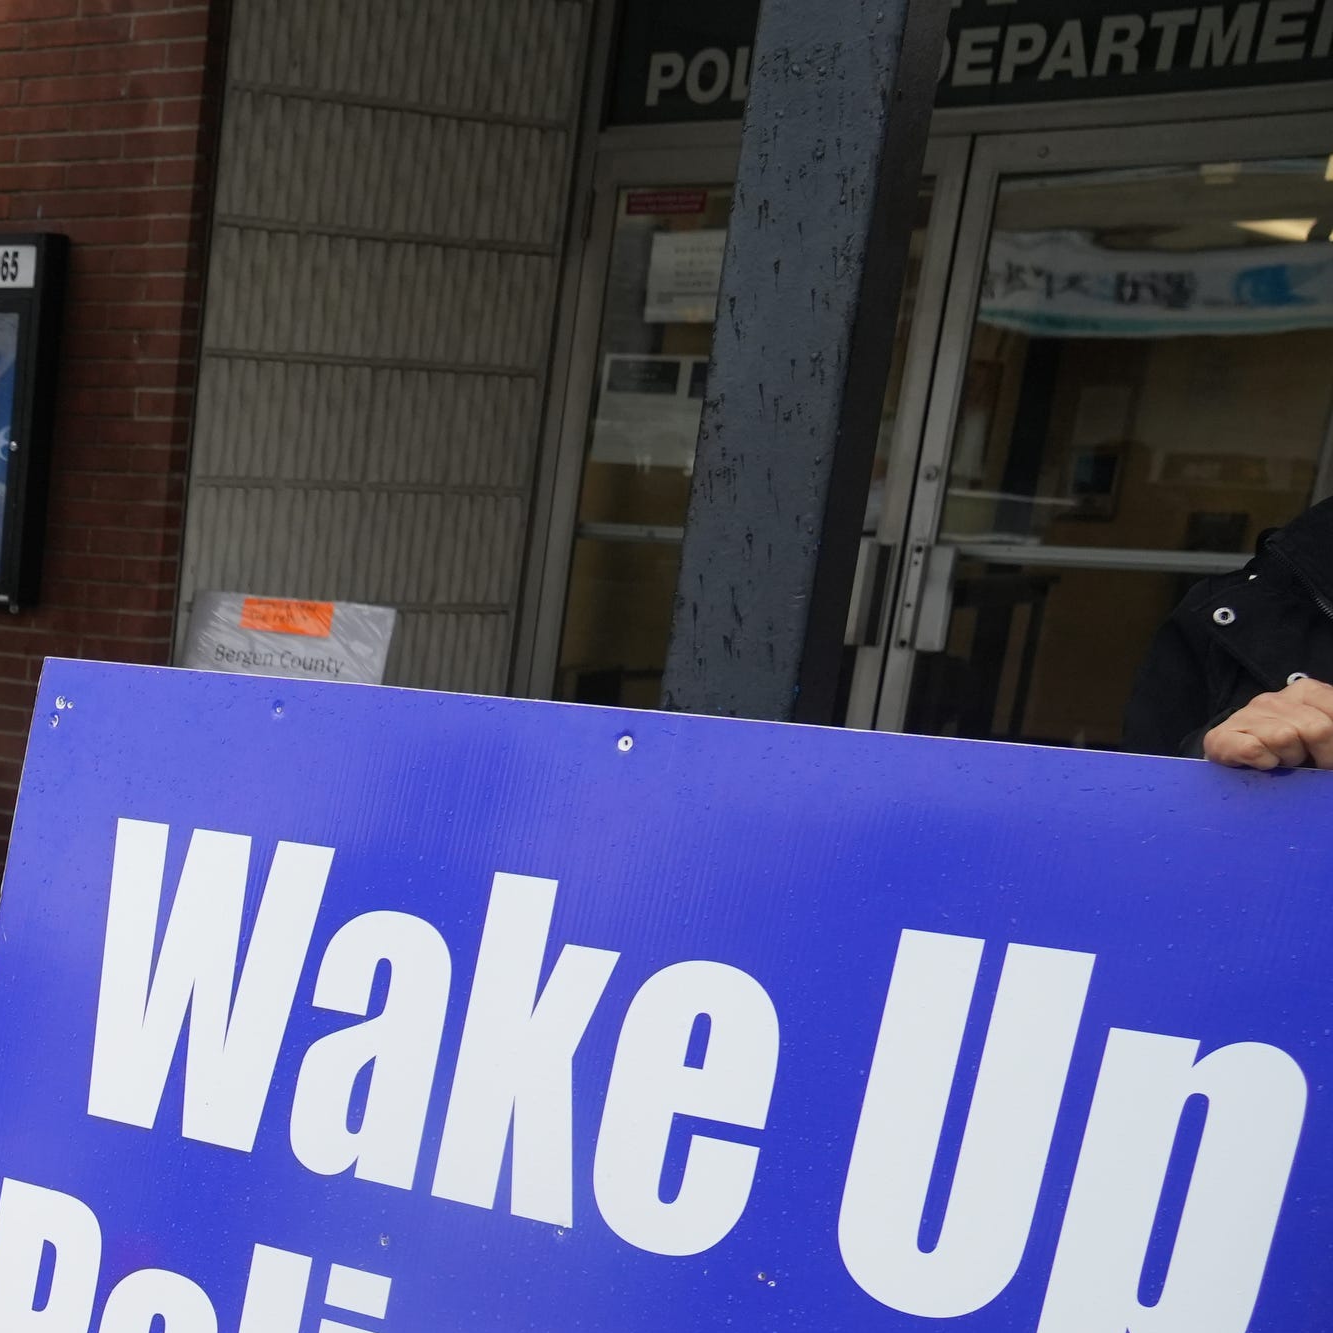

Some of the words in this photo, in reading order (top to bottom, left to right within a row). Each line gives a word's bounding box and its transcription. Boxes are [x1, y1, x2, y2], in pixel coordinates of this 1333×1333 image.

[937, 0, 1333, 87] EPARTME
[214, 644, 274, 668] Bergen
[280, 650, 345, 678] County
[88, 818, 779, 1256] Wake
